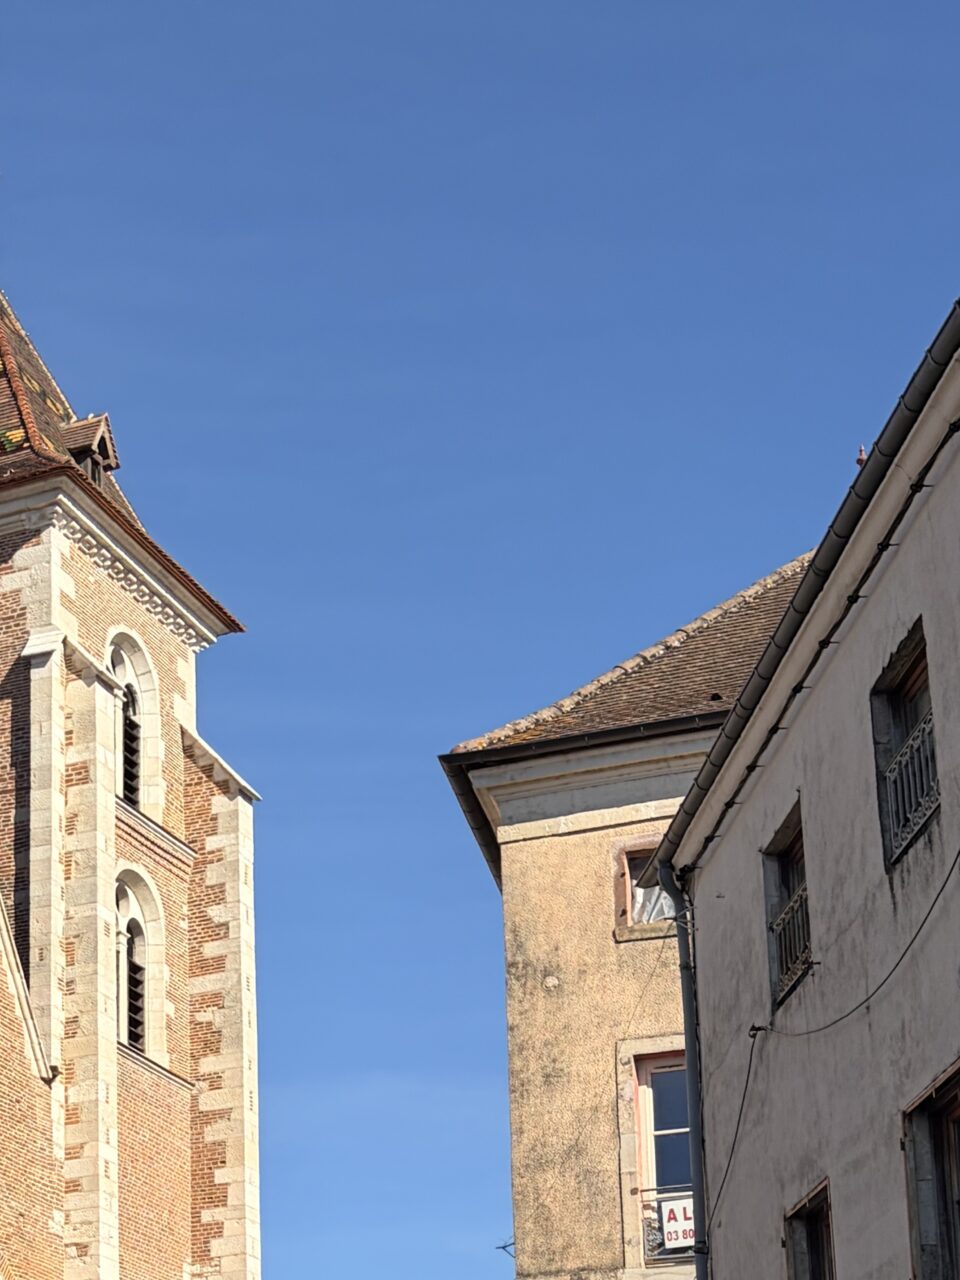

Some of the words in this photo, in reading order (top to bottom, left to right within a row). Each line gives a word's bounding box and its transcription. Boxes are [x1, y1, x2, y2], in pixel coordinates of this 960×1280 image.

[667, 1208, 678, 1223] A
[667, 1230, 679, 1242] 03
[682, 1228, 696, 1240] 80
